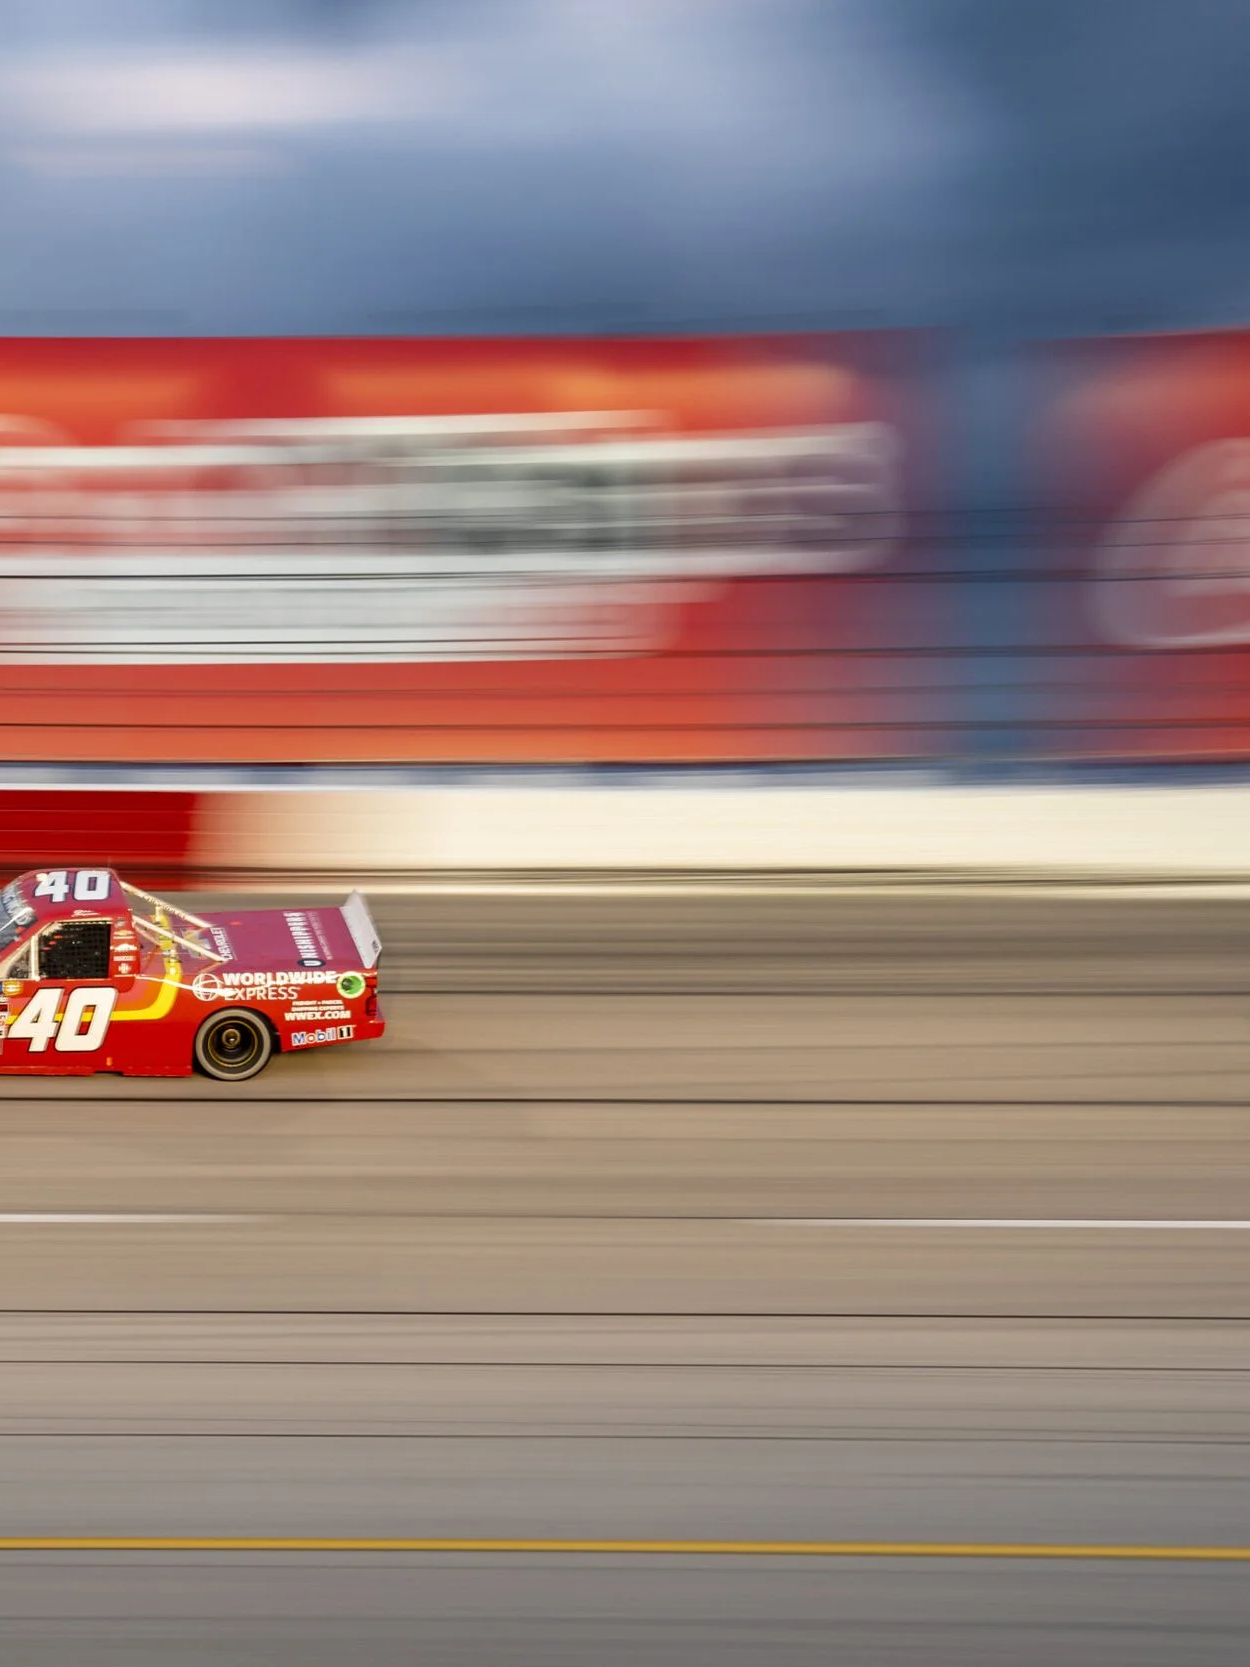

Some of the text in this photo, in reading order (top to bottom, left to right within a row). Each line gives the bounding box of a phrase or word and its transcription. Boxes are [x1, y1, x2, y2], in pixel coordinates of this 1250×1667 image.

[35, 870, 111, 903] 40
[283, 912, 322, 967] UNISHIPPERS
[222, 971, 337, 986] WORLDWIDE
[225, 986, 299, 1000] EXPRESS
[7, 987, 118, 1052] 40
[284, 1010, 351, 1021] WWEX.COM
[291, 1025, 354, 1047] Mobil 1
